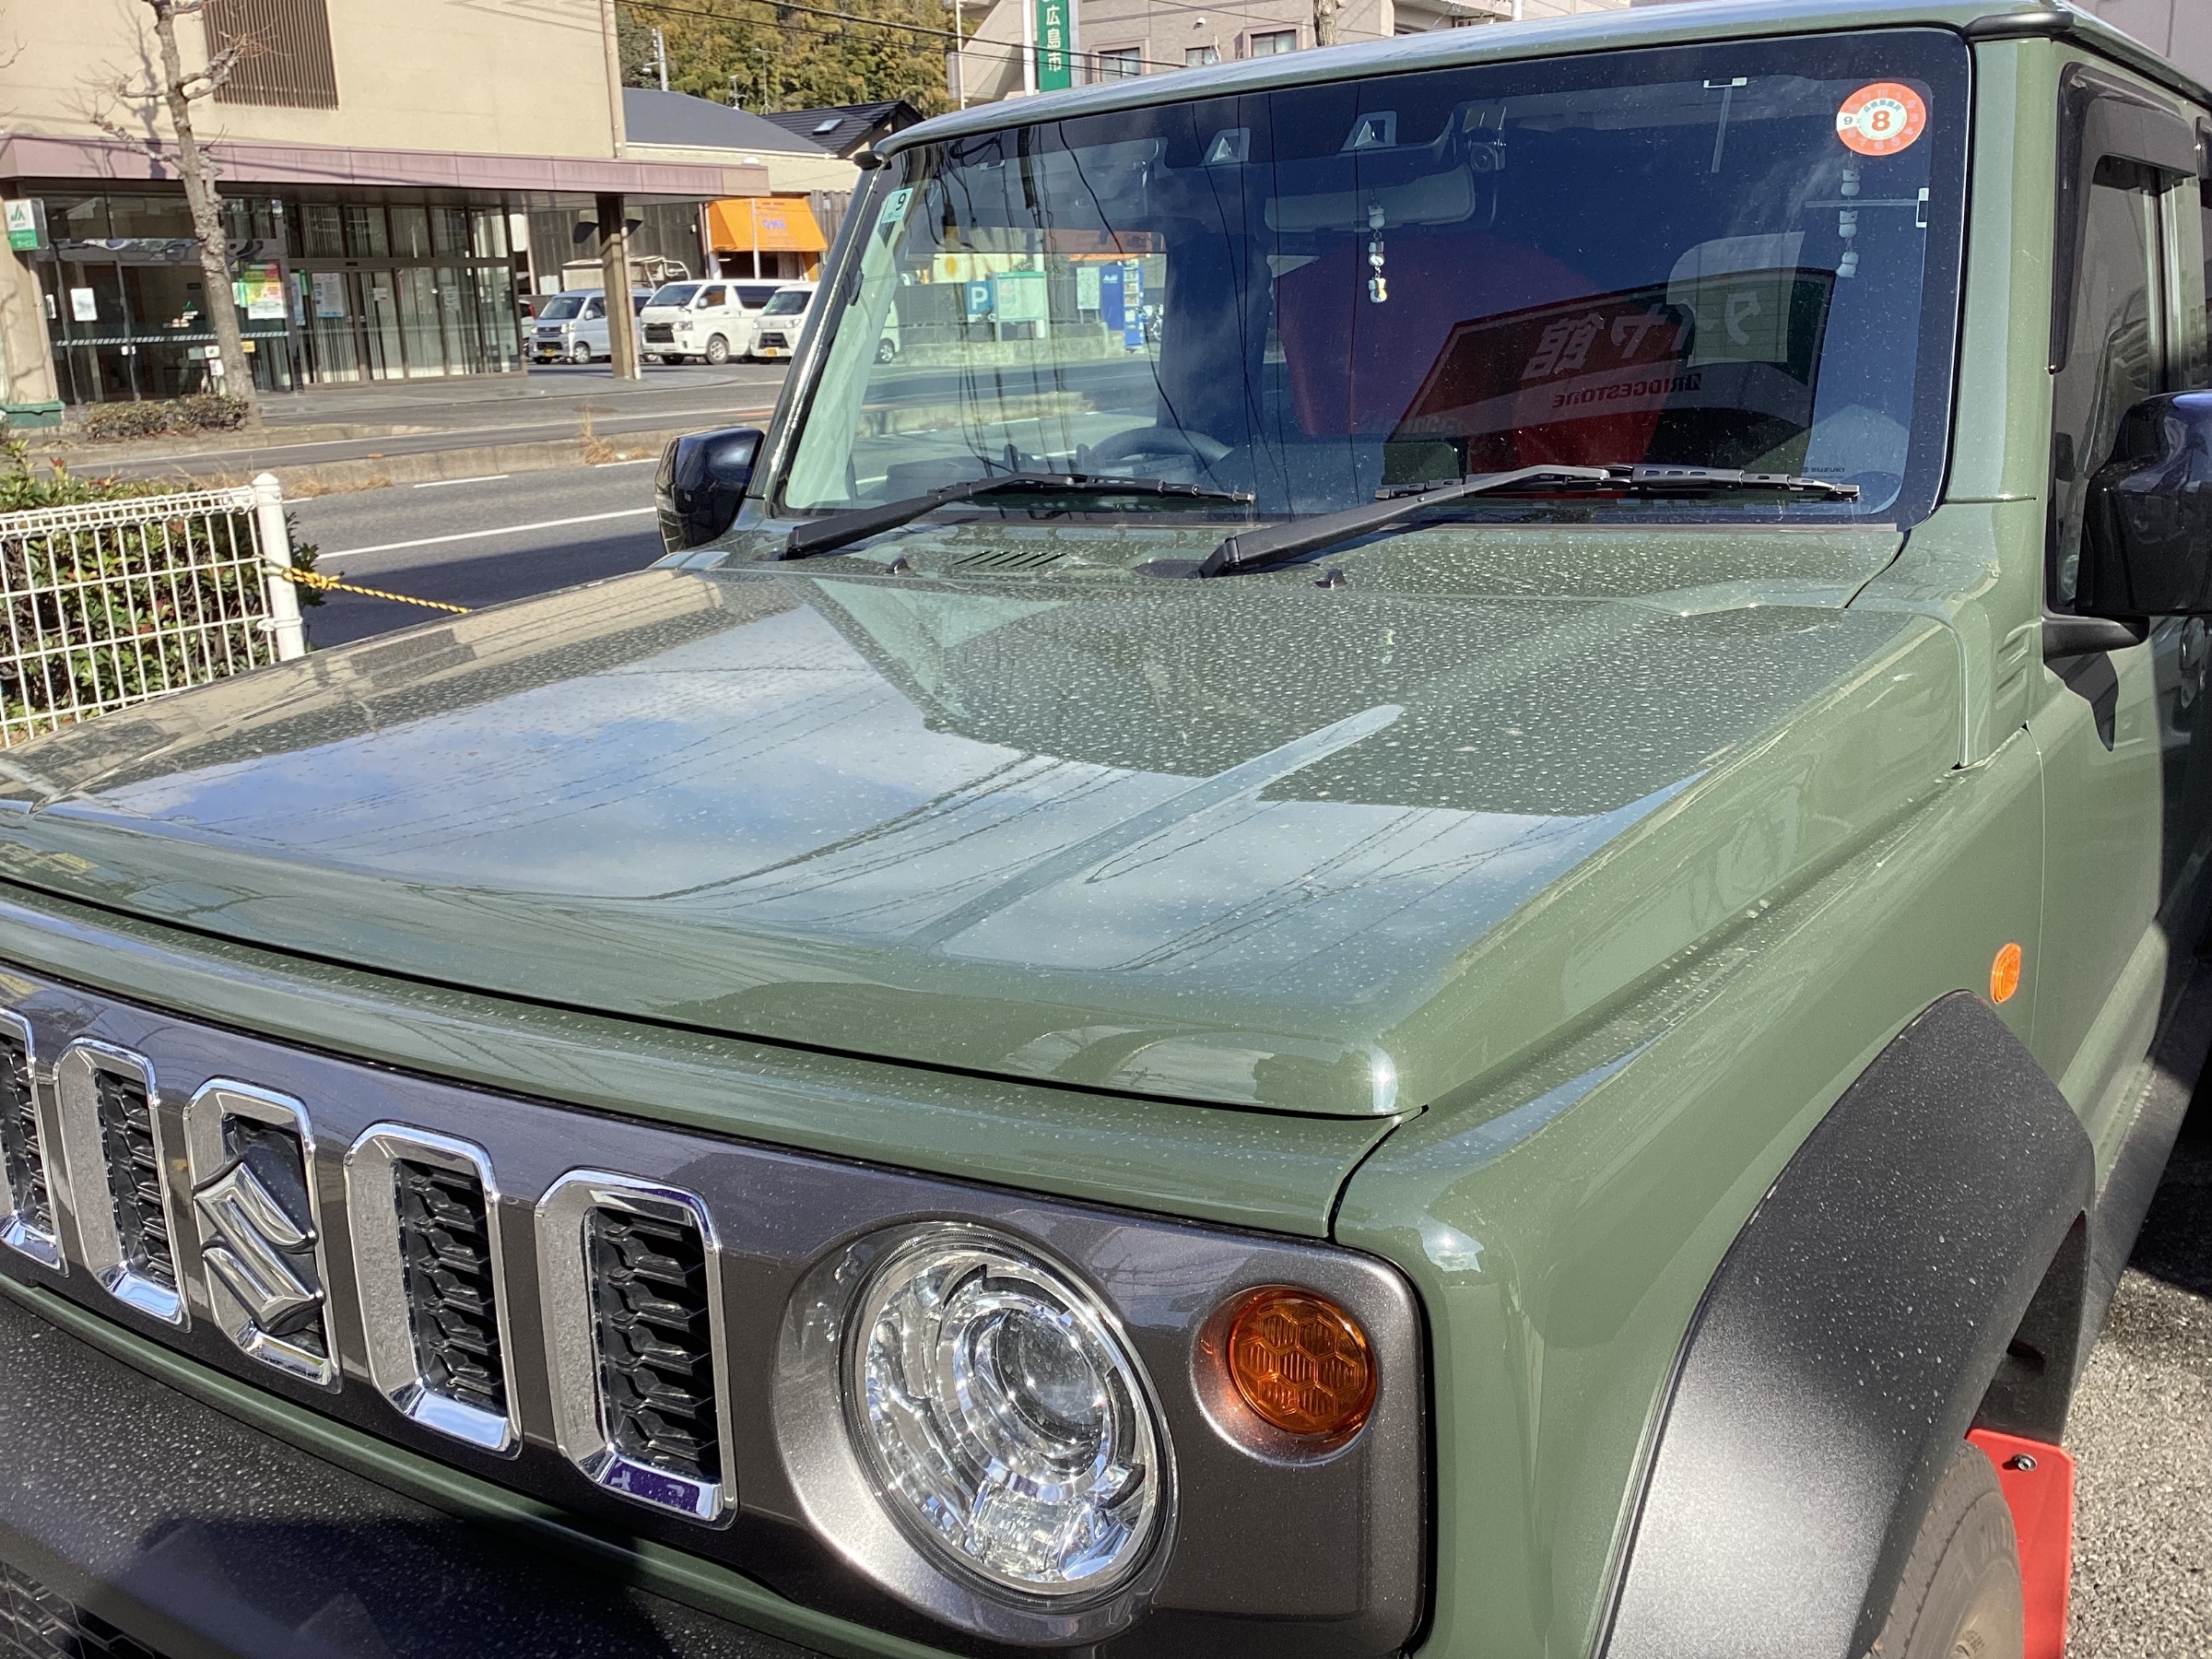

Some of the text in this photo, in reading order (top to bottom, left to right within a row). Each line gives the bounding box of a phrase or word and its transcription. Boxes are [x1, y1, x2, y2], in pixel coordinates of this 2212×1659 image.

[1046, 5, 1062, 72] 広島市
[1843, 116, 1853, 125] 9
[1872, 111, 1890, 132] 8
[895, 193, 906, 211] 9
[971, 287, 989, 310] P
